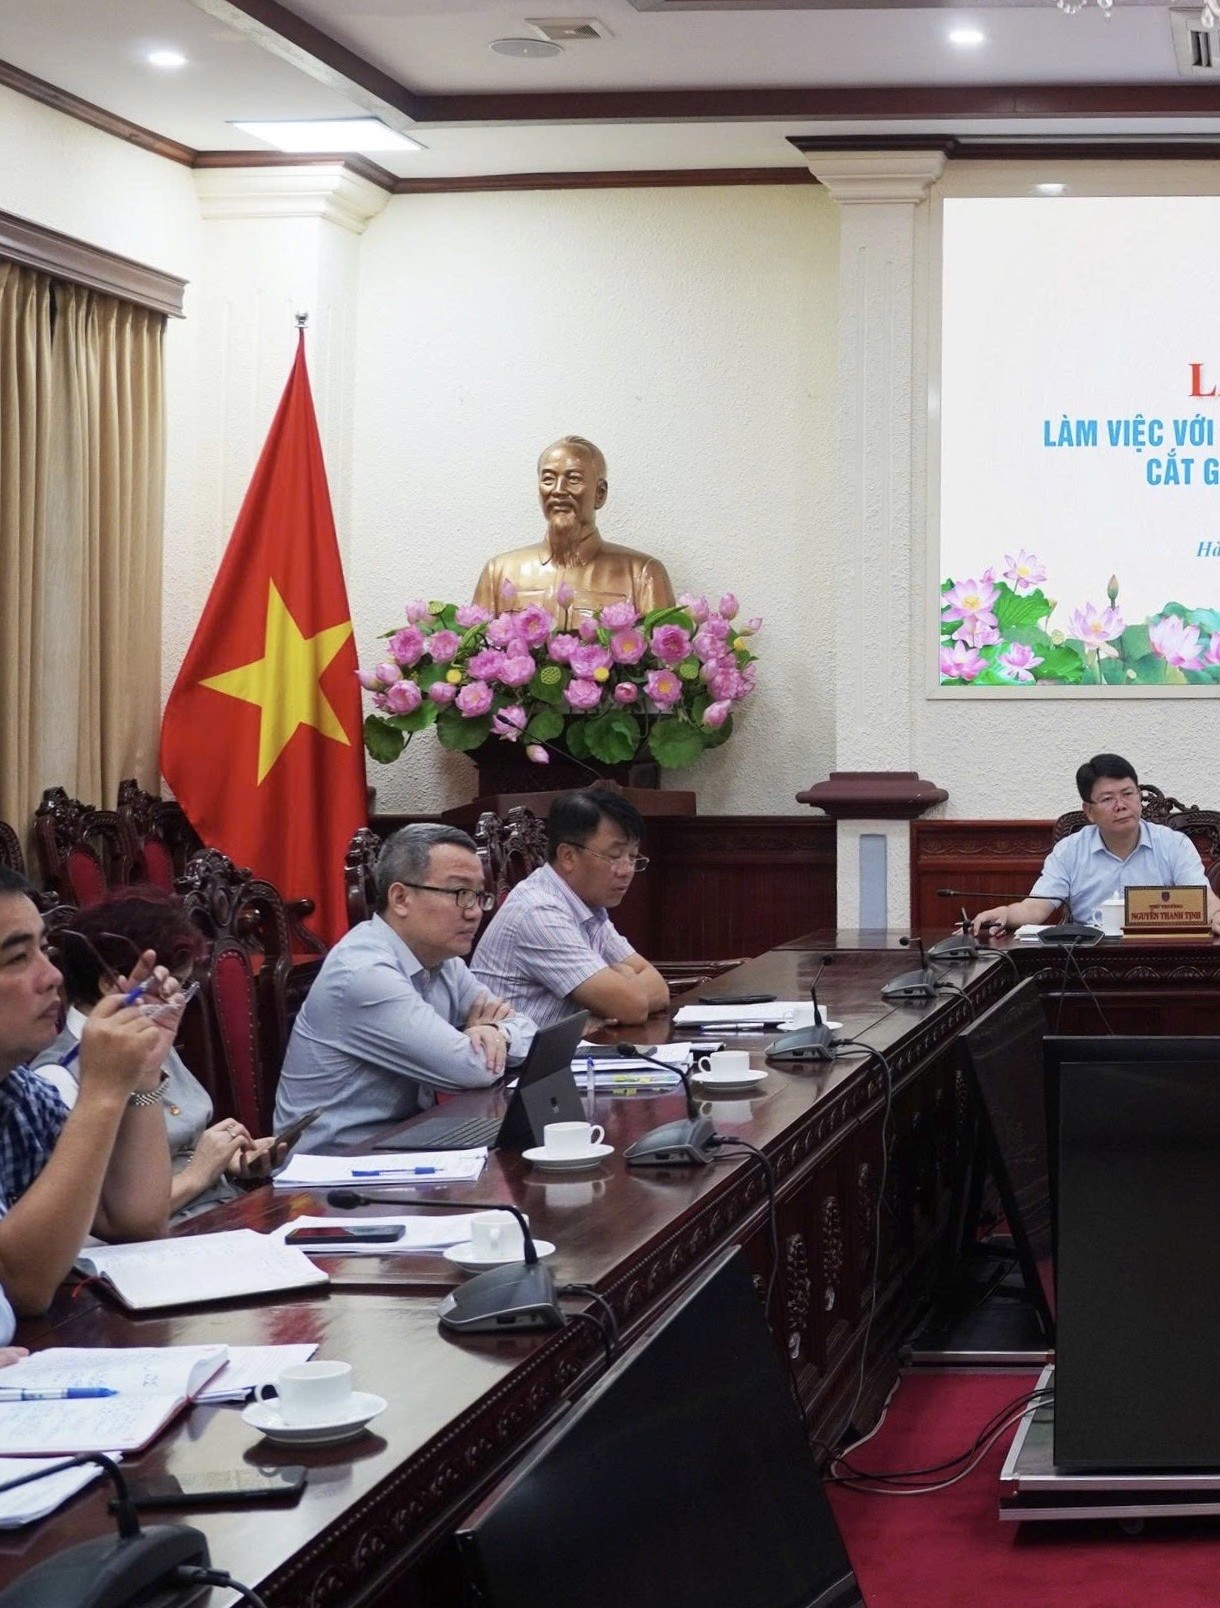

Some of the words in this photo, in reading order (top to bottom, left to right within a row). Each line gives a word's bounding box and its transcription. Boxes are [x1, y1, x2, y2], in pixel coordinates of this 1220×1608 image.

[1043, 414, 1098, 447] LÀM
[1107, 413, 1165, 453] VIỆC
[1173, 413, 1214, 447] VỚI
[1146, 448, 1195, 486] CẮT
[1160, 911, 1184, 921] THANH
